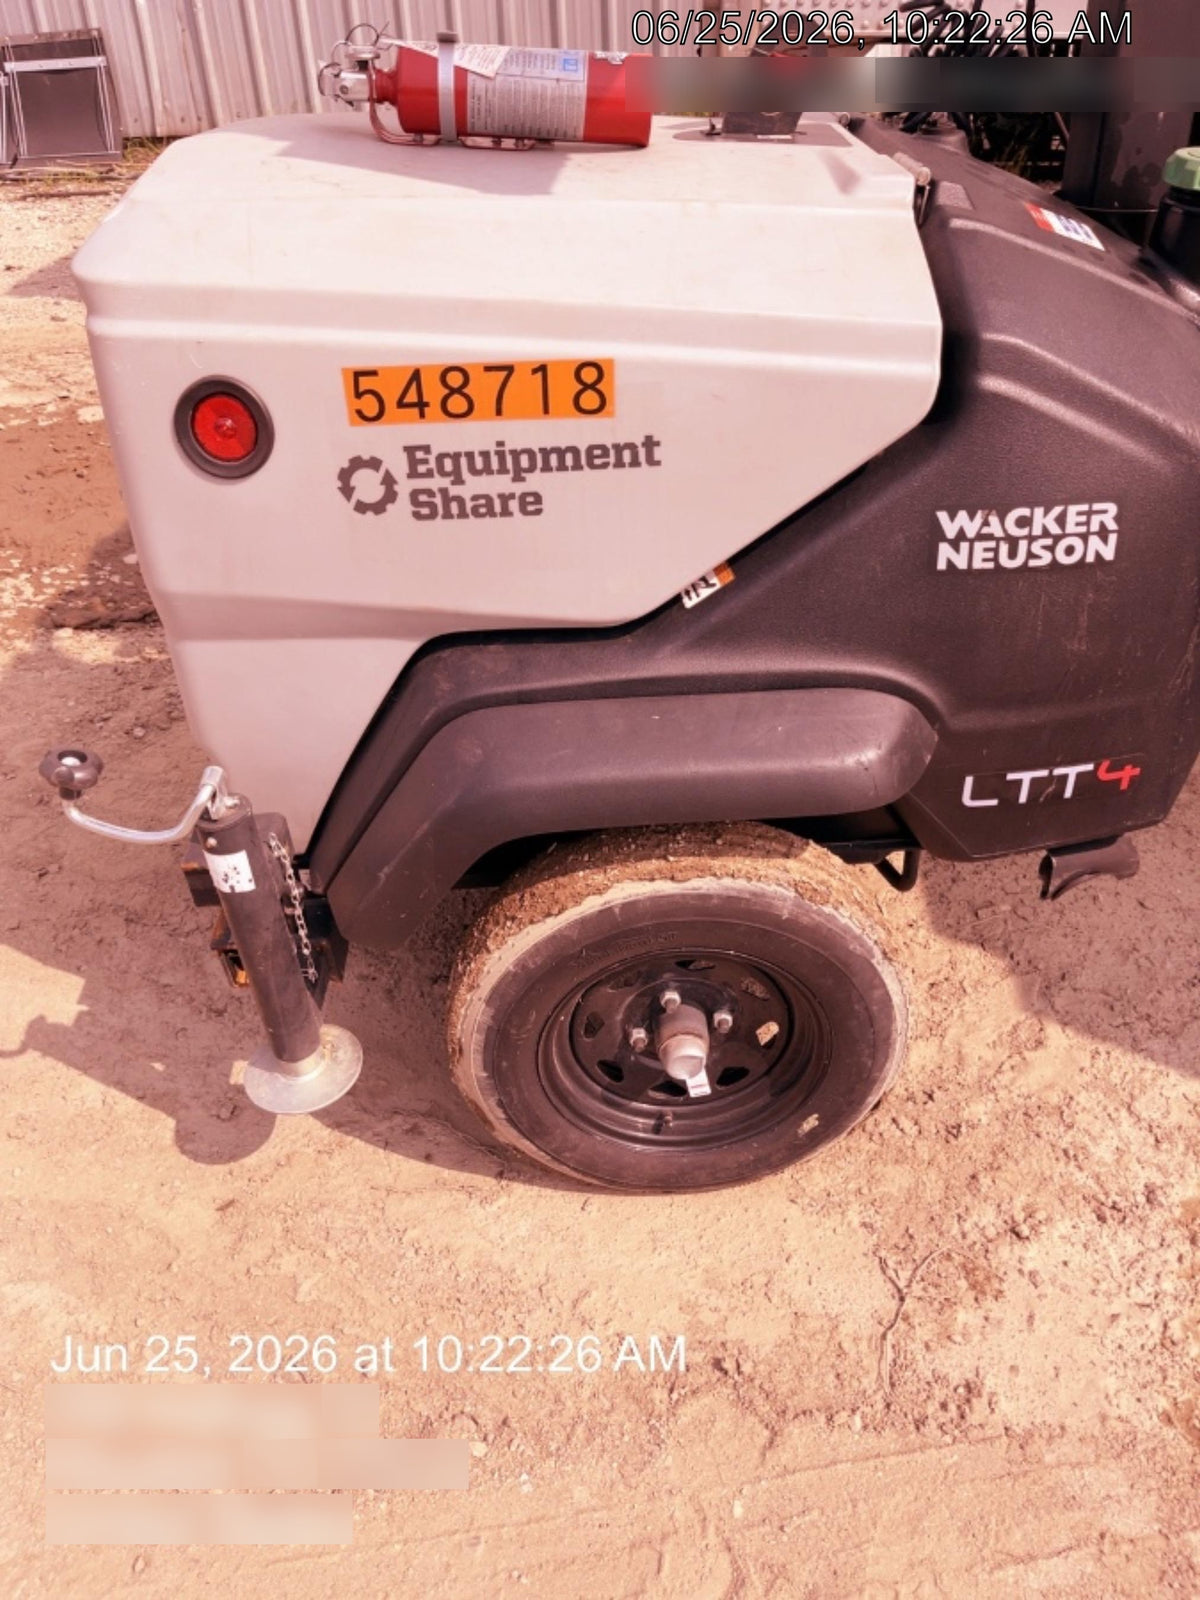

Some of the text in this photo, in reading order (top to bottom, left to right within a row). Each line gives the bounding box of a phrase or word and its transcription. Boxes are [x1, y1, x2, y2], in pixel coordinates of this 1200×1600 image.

[352, 361, 608, 423] 548718
[403, 435, 662, 486] Equipment
[409, 487, 544, 521] Share
[935, 502, 1119, 539] WACKER
[936, 532, 1118, 571] NEUSON
